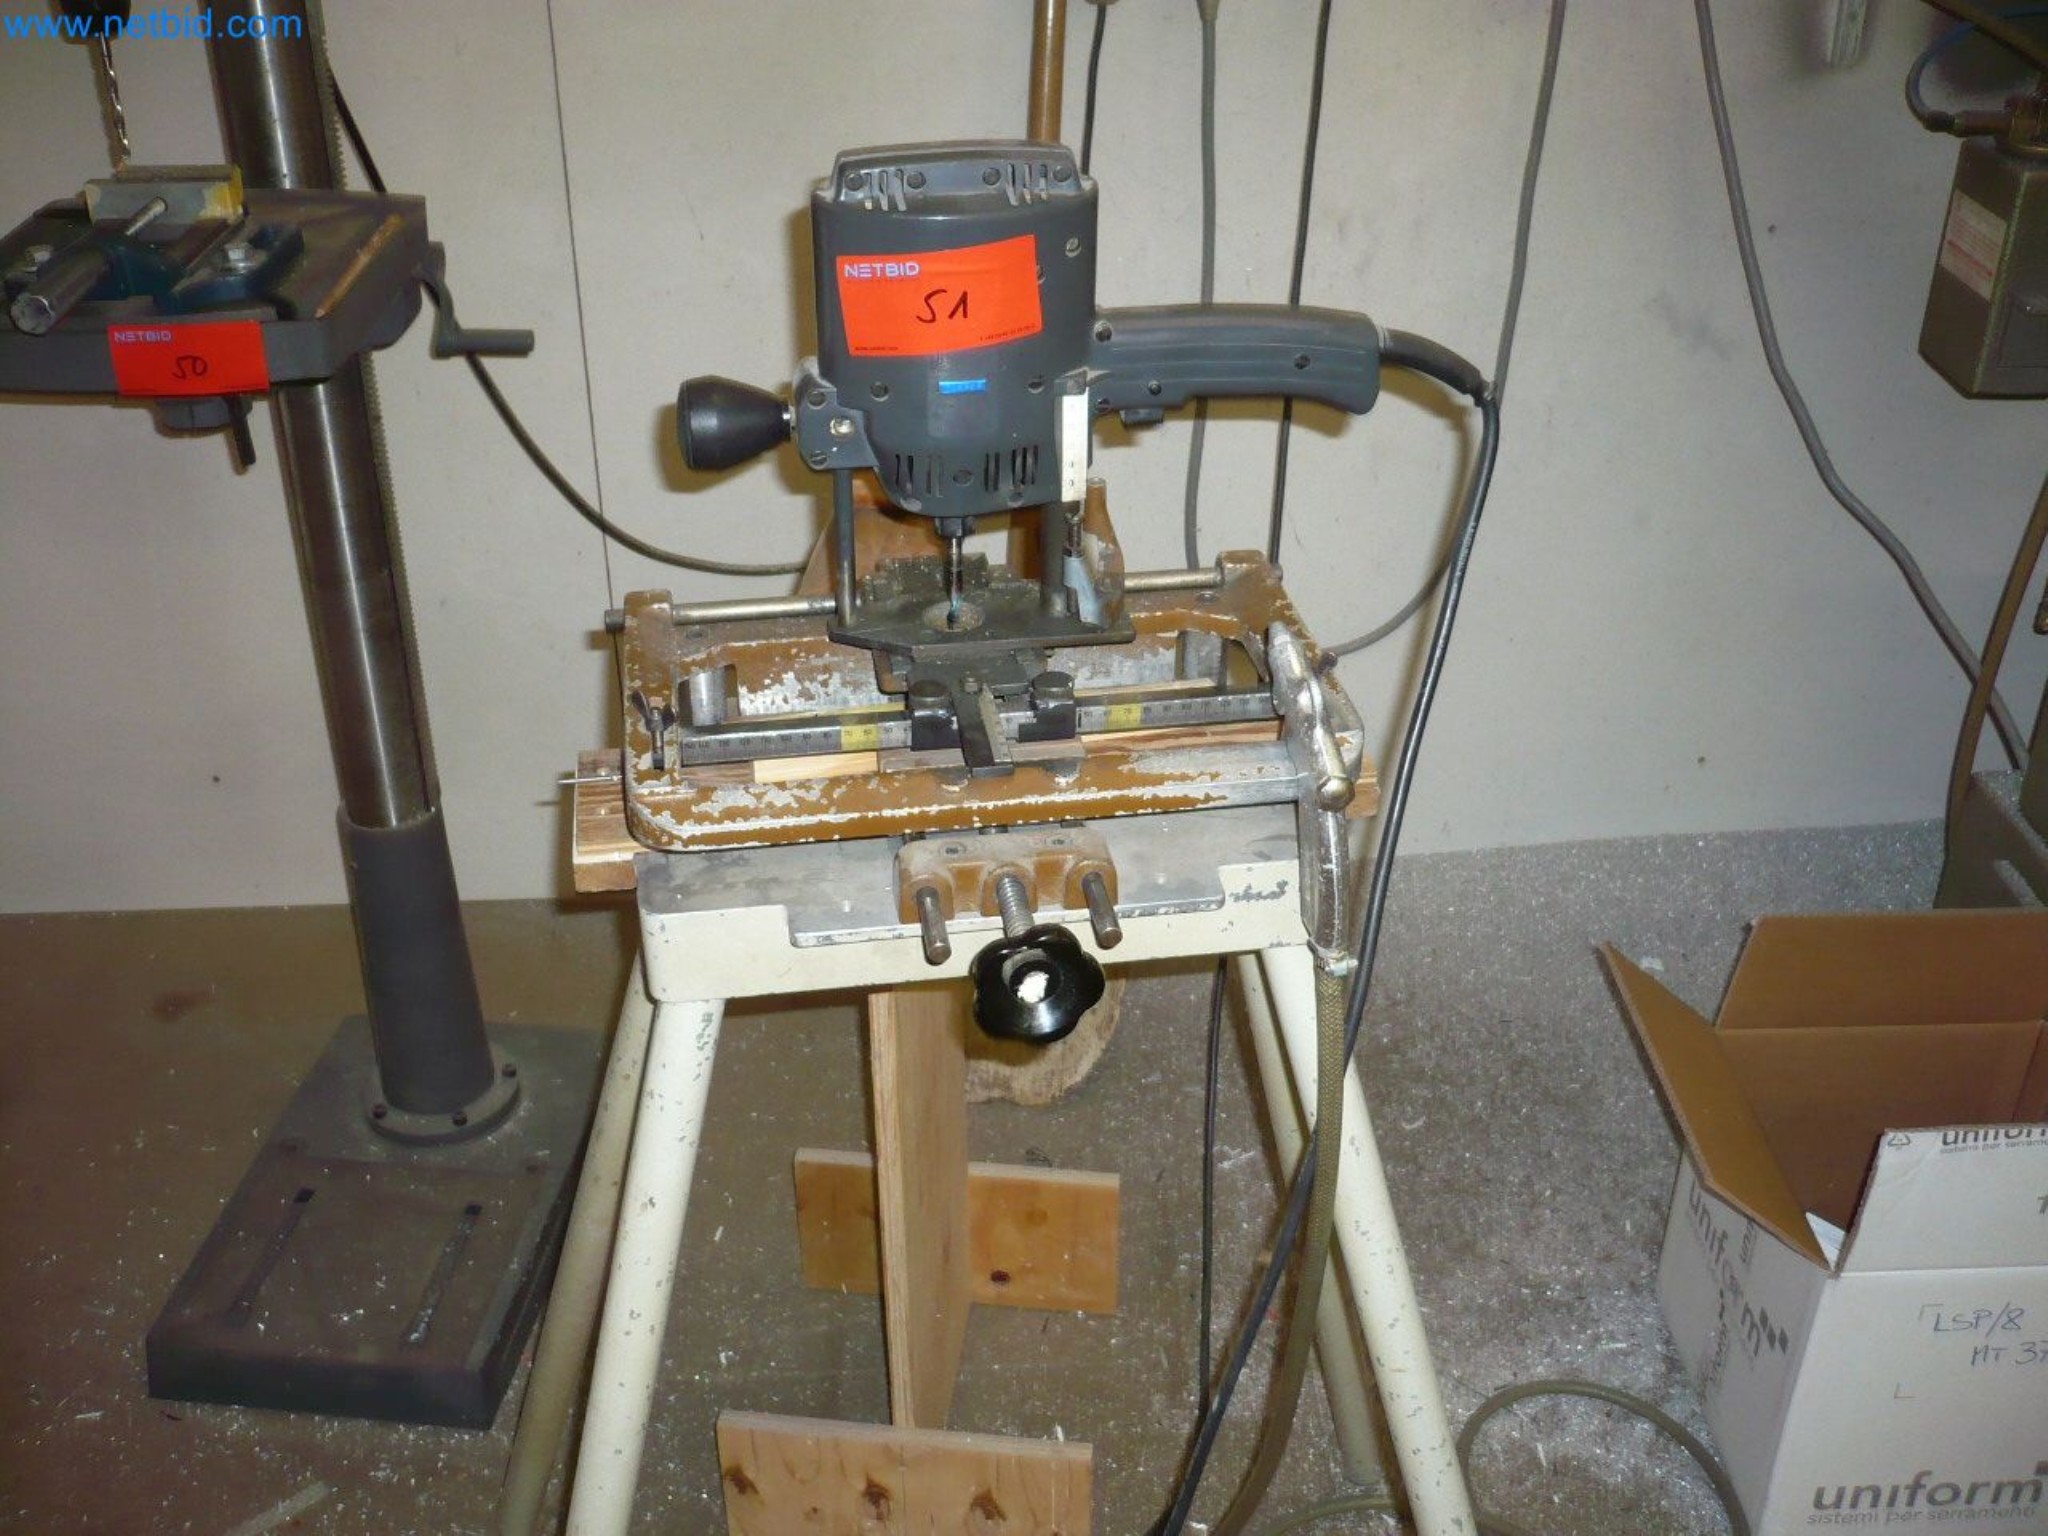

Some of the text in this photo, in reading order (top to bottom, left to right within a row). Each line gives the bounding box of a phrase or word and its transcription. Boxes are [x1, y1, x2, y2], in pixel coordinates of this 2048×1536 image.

[844, 261, 920, 278] NETBID
[114, 330, 172, 343] NETBID
[1813, 1470, 2043, 1510] uniform
[1807, 1510, 1879, 1525] sistemi
[1886, 1509, 1923, 1526] per
